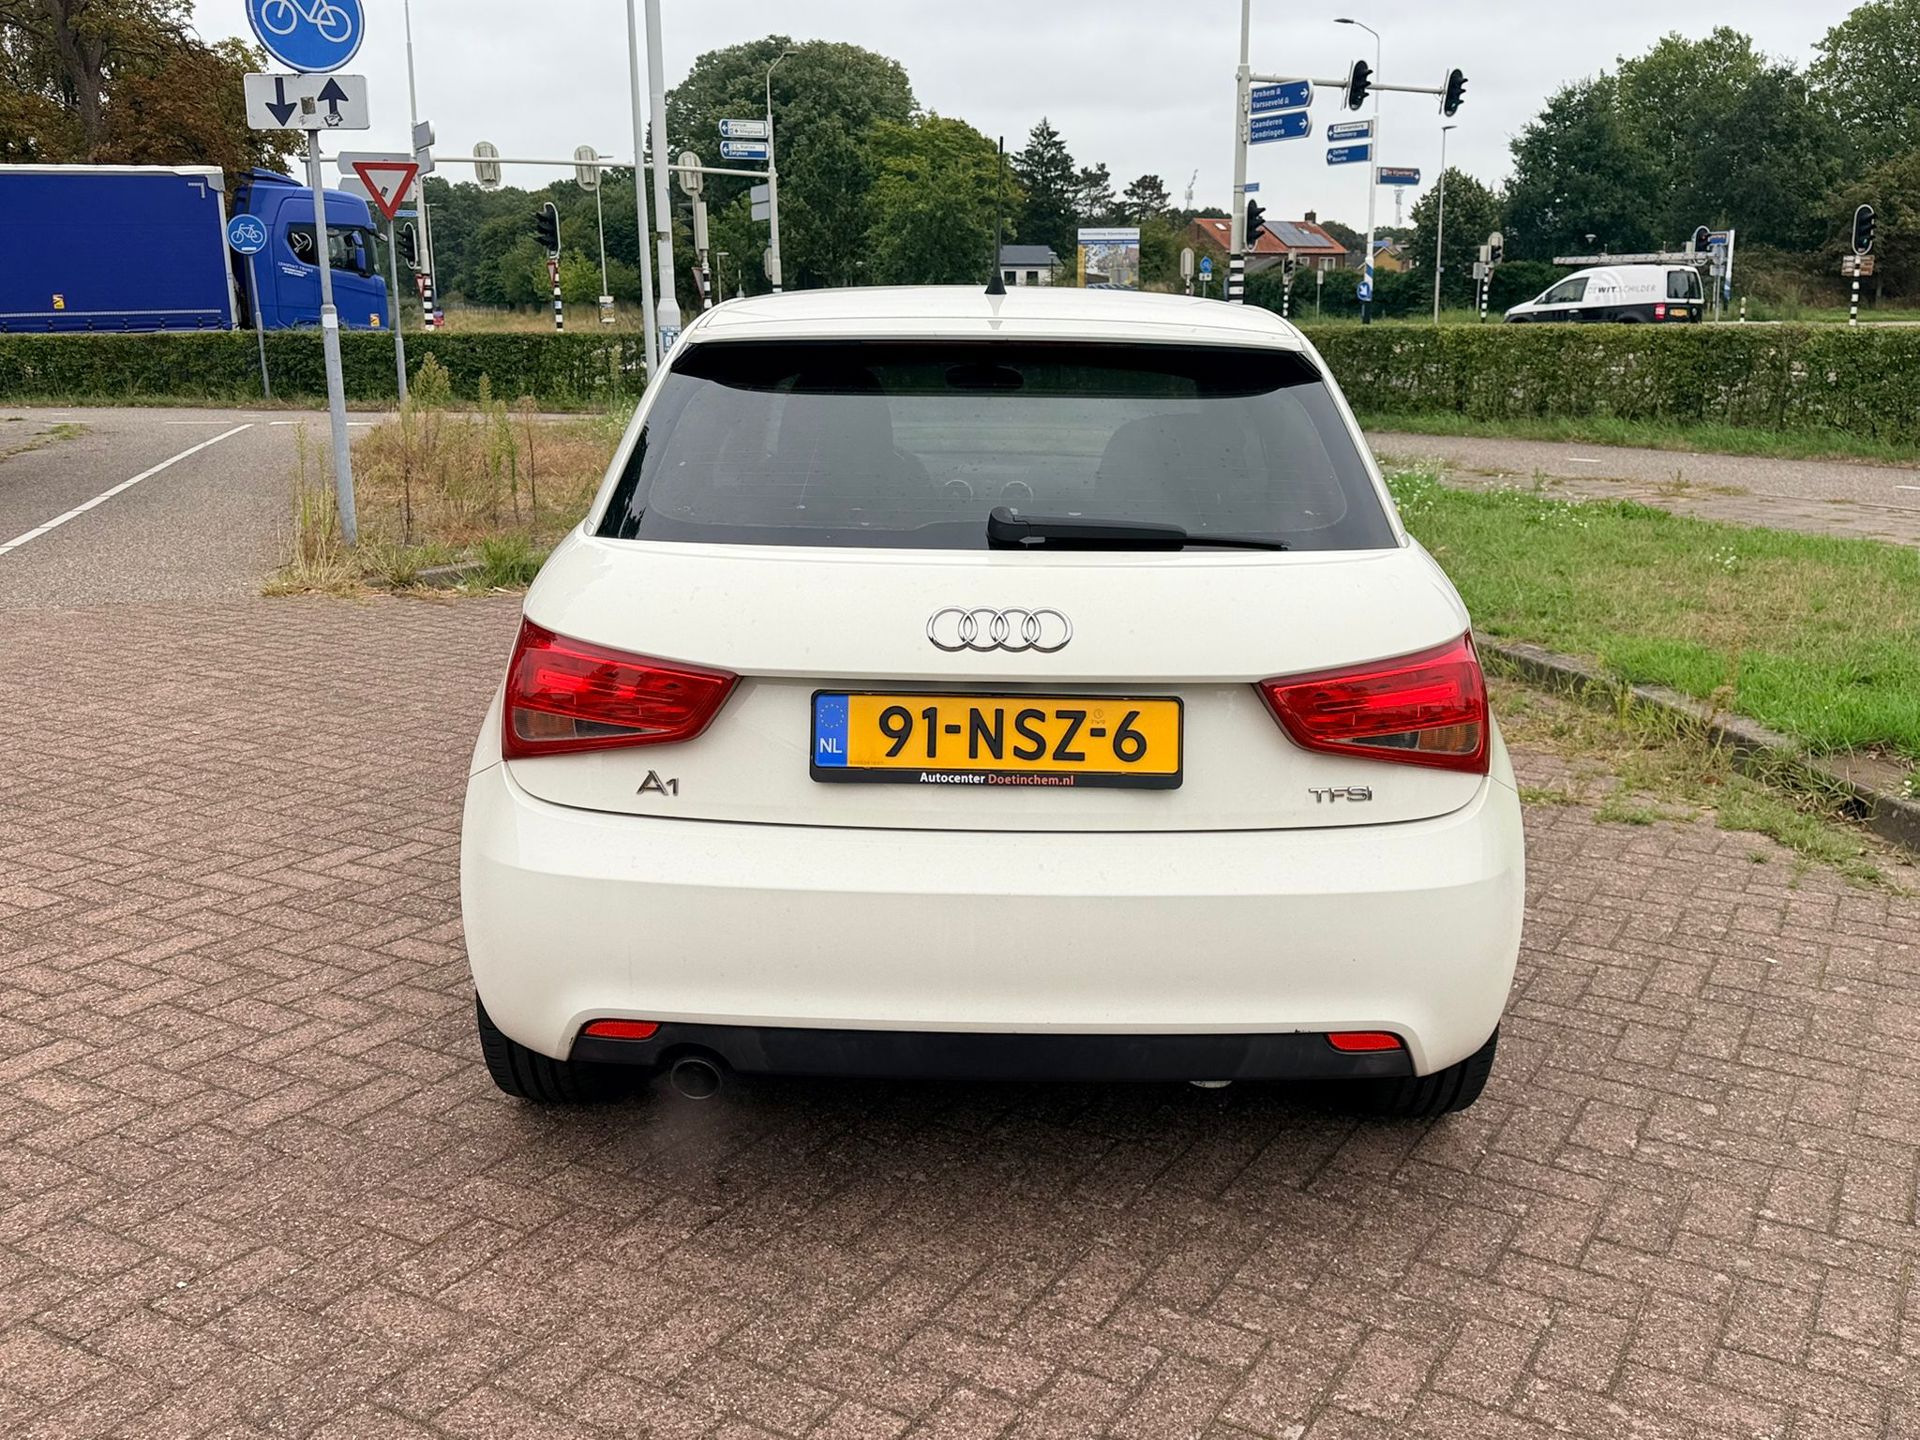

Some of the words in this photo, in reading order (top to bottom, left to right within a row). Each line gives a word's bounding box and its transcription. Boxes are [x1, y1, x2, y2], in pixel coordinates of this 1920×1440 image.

[878, 705, 1147, 762] 91-NSZ-6
[820, 738, 842, 753] NL
[636, 769, 679, 796] A1
[919, 772, 985, 784] Autocenter
[988, 774, 1074, 786] Doetinchem.nl
